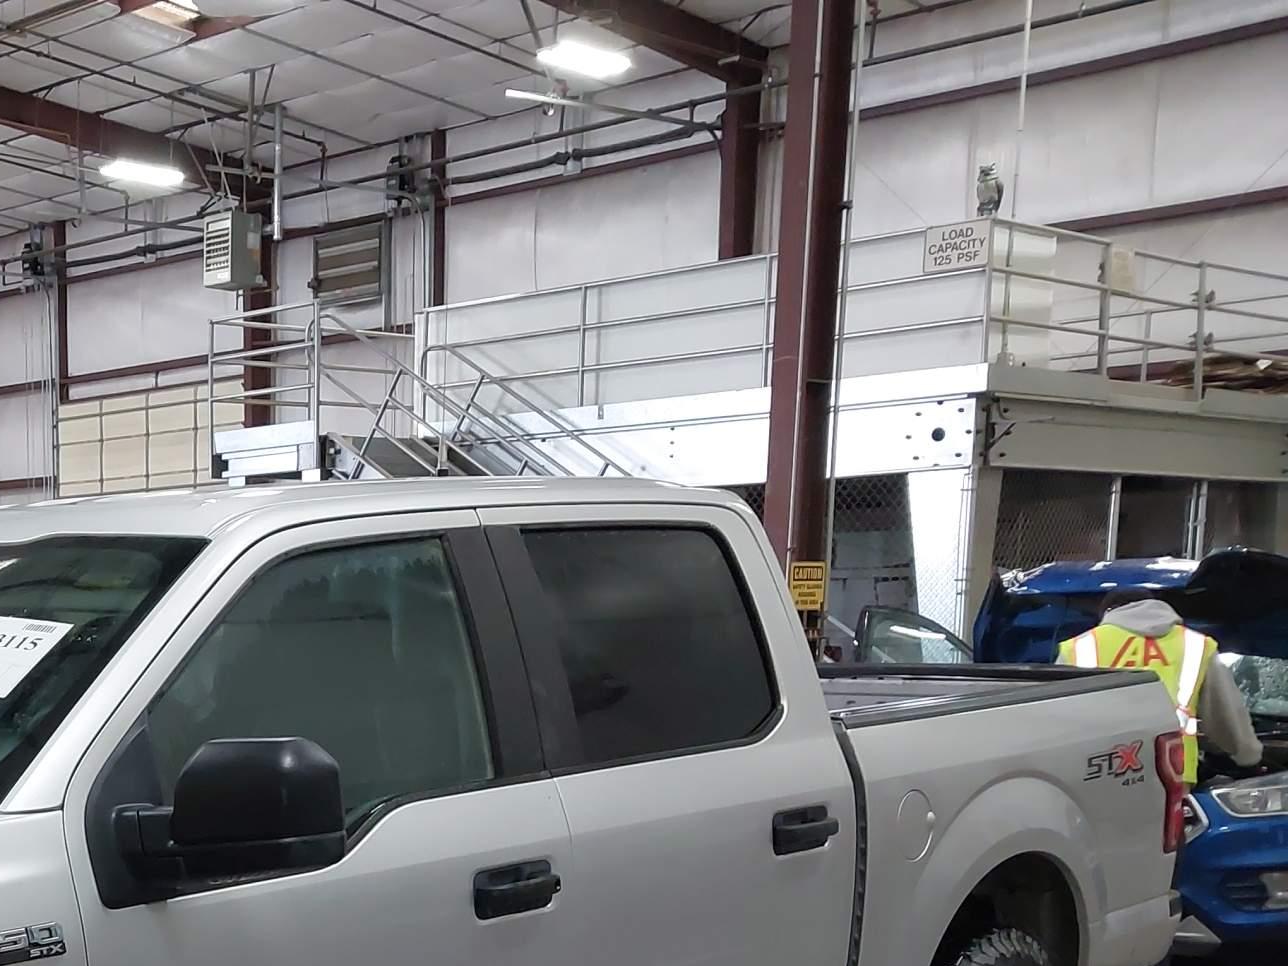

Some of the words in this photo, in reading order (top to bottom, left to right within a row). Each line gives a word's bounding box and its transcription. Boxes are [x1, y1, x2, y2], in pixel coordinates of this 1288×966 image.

[941, 226, 975, 242] LOAD
[927, 236, 987, 256] CAPACITY
[933, 254, 953, 267] 125
[956, 249, 981, 264] PSF
[1084, 739, 1144, 779] STX
[29, 943, 64, 959] STX
